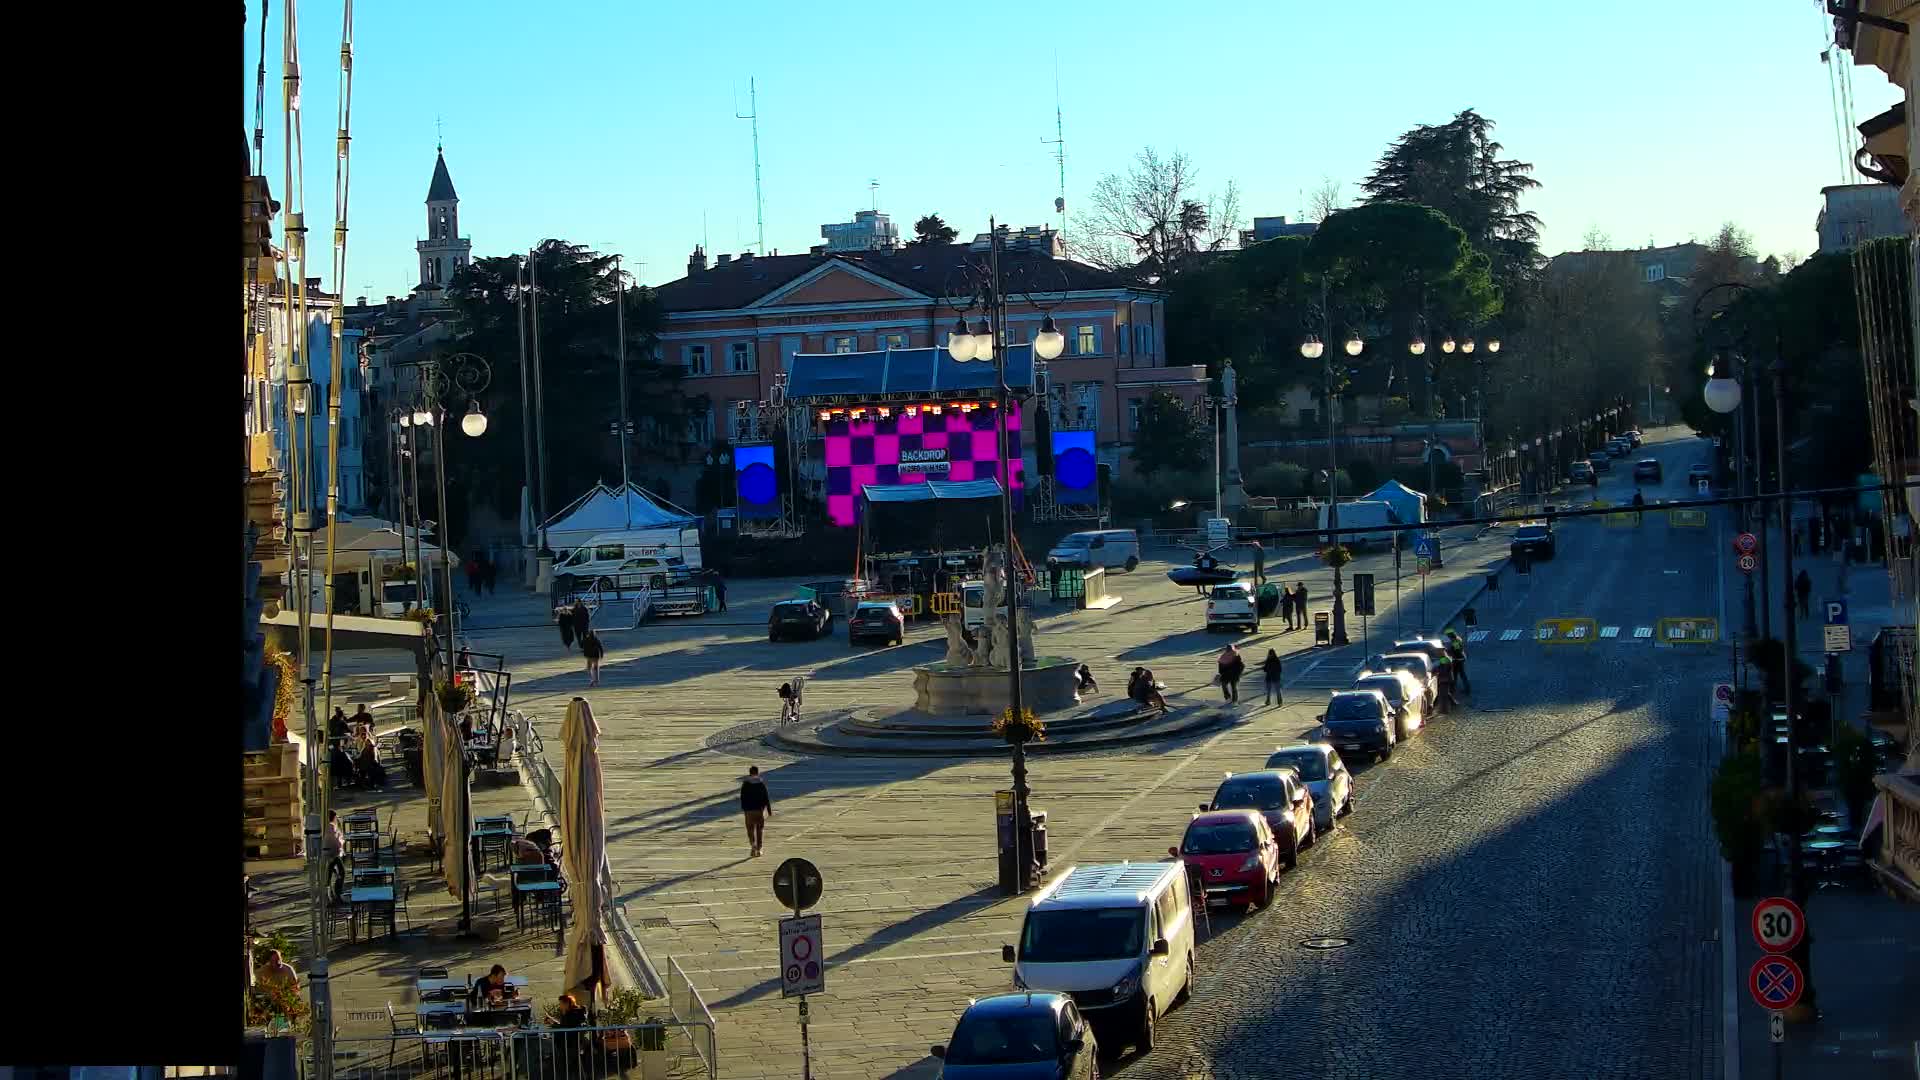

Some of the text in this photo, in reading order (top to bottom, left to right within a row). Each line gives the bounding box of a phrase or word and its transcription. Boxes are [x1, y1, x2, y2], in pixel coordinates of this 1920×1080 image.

[901, 449, 946, 461] BACKDROP
[1743, 556, 1754, 568] 20
[1827, 602, 1842, 623] P
[1762, 912, 1792, 938] 30
